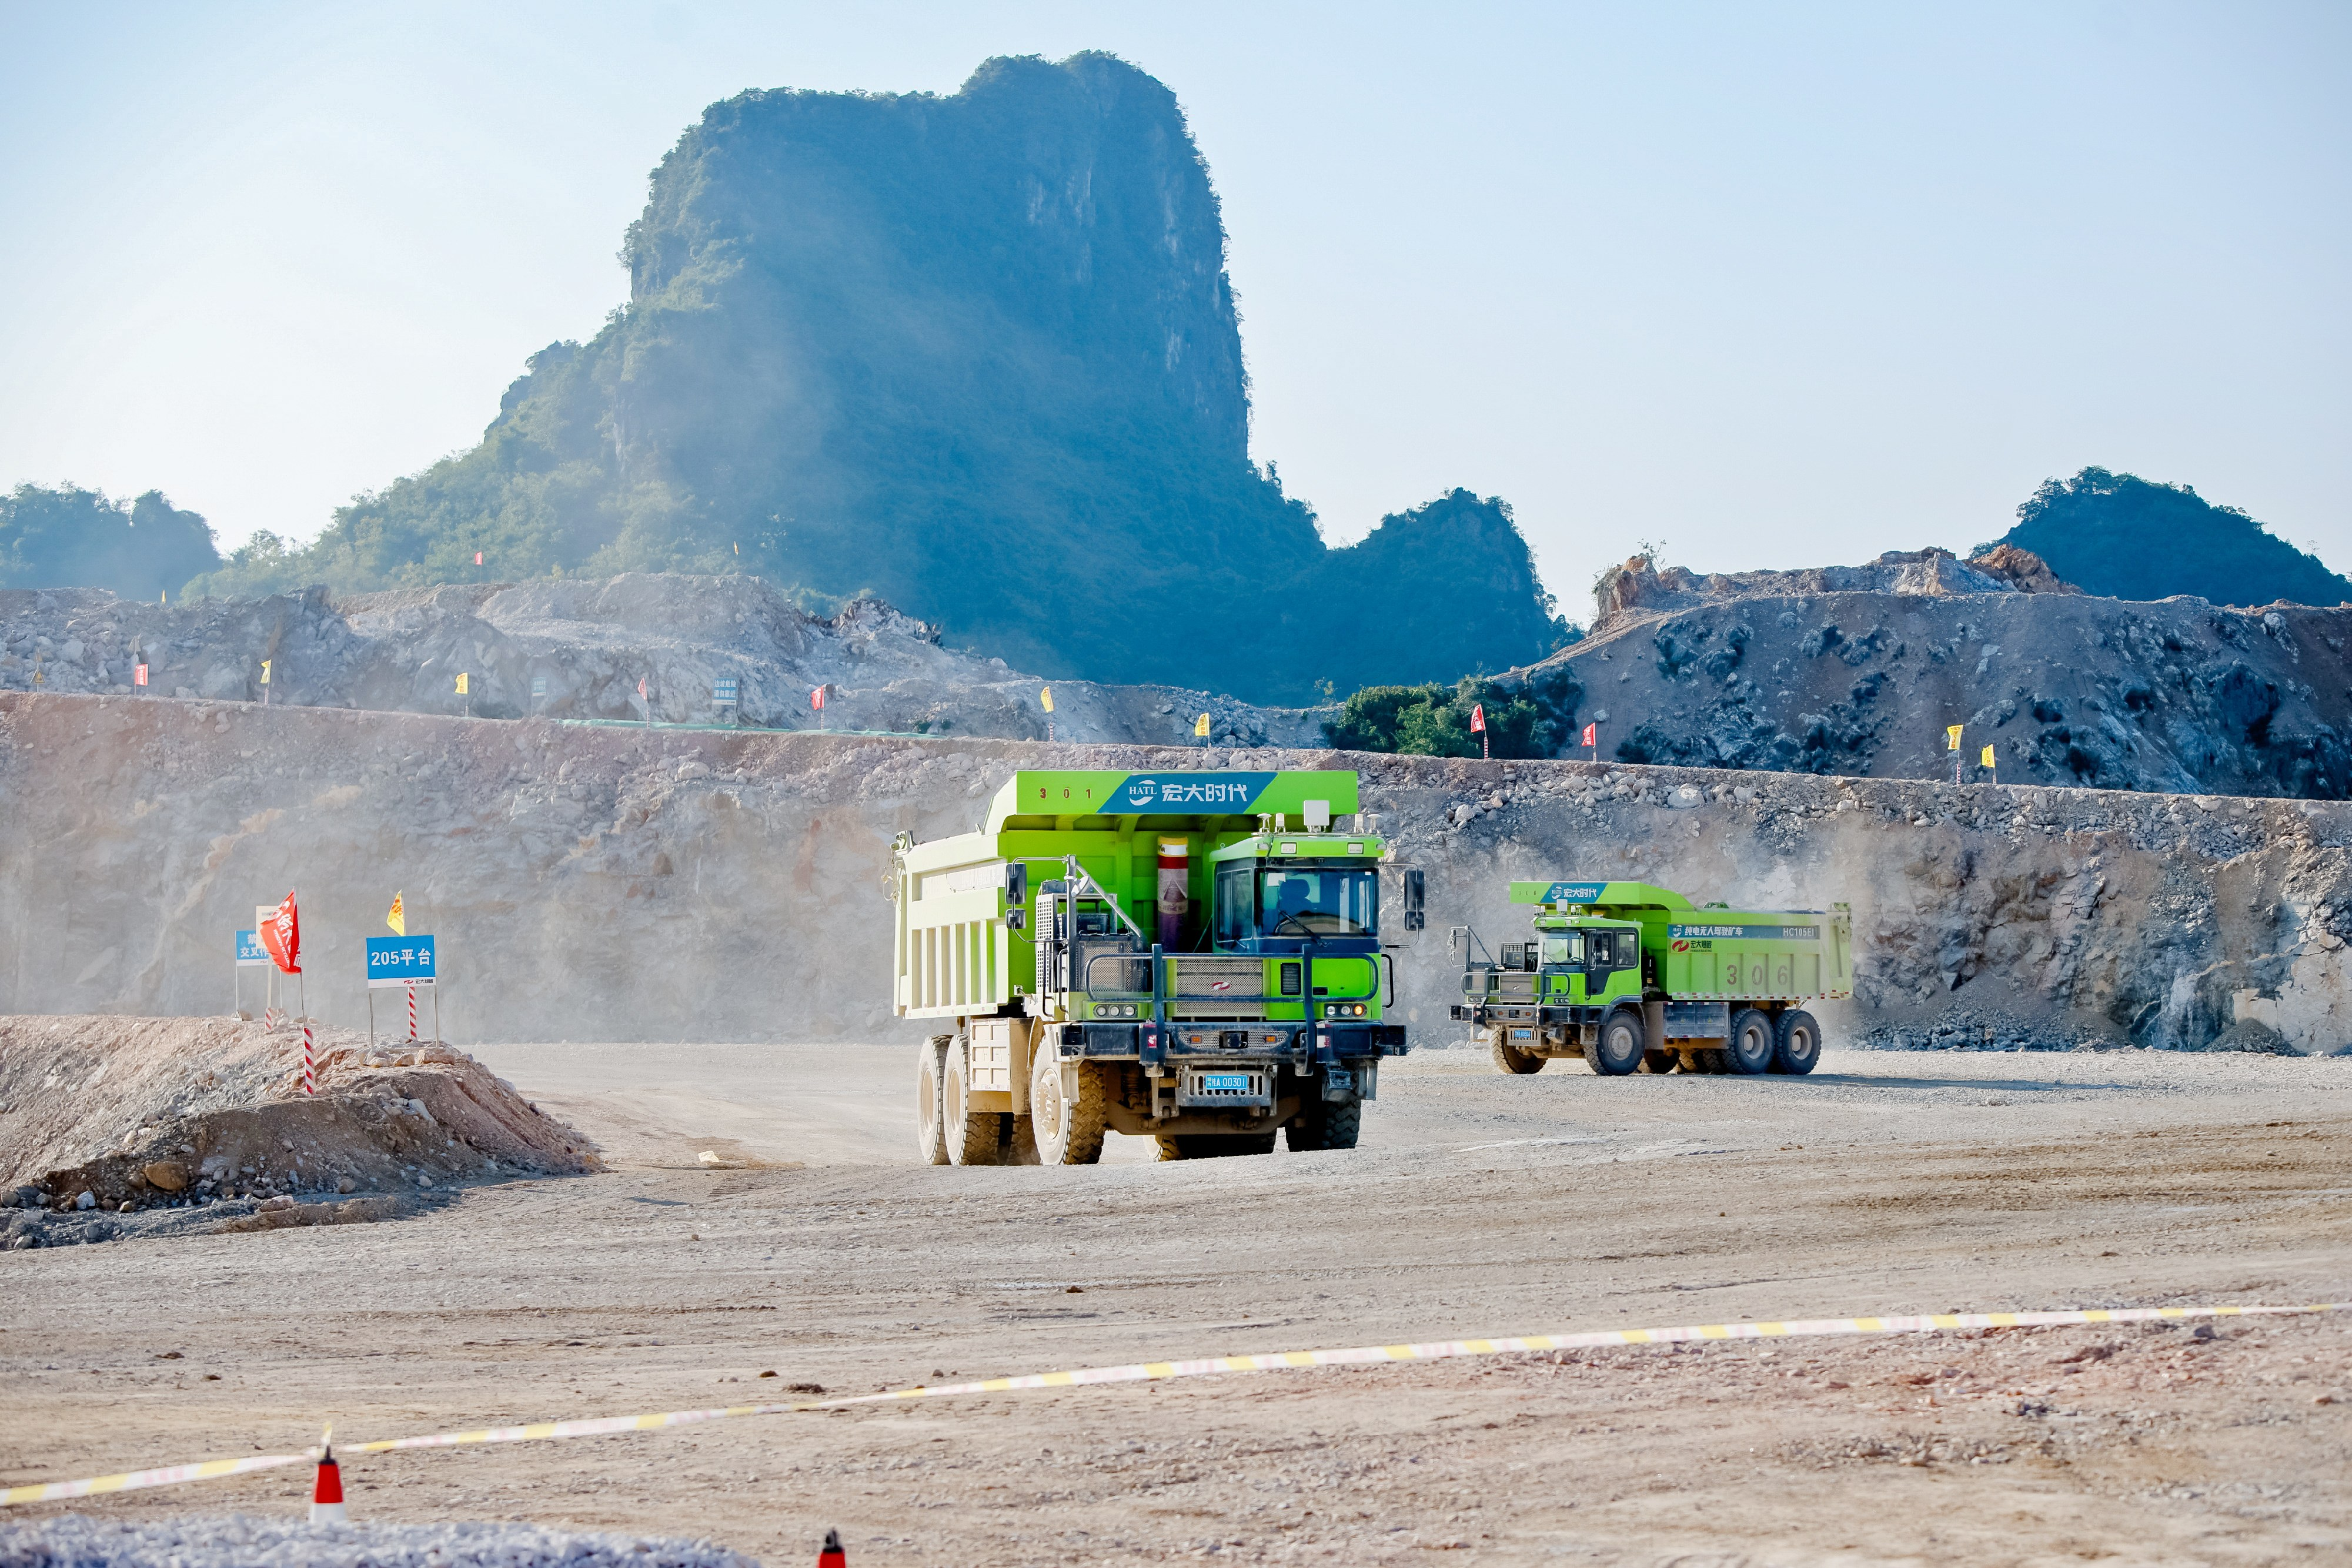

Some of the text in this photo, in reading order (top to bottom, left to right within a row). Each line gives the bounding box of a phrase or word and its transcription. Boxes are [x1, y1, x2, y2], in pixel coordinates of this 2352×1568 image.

[1128, 786, 1157, 795] HATL
[1162, 784, 1247, 802] 宏大时代
[1563, 888, 1597, 898] 宏大时代
[1685, 926, 1743, 936] 纯电无人驾驶矿车
[240, 947, 269, 957] 交叉作
[371, 948, 431, 966] 205平台
